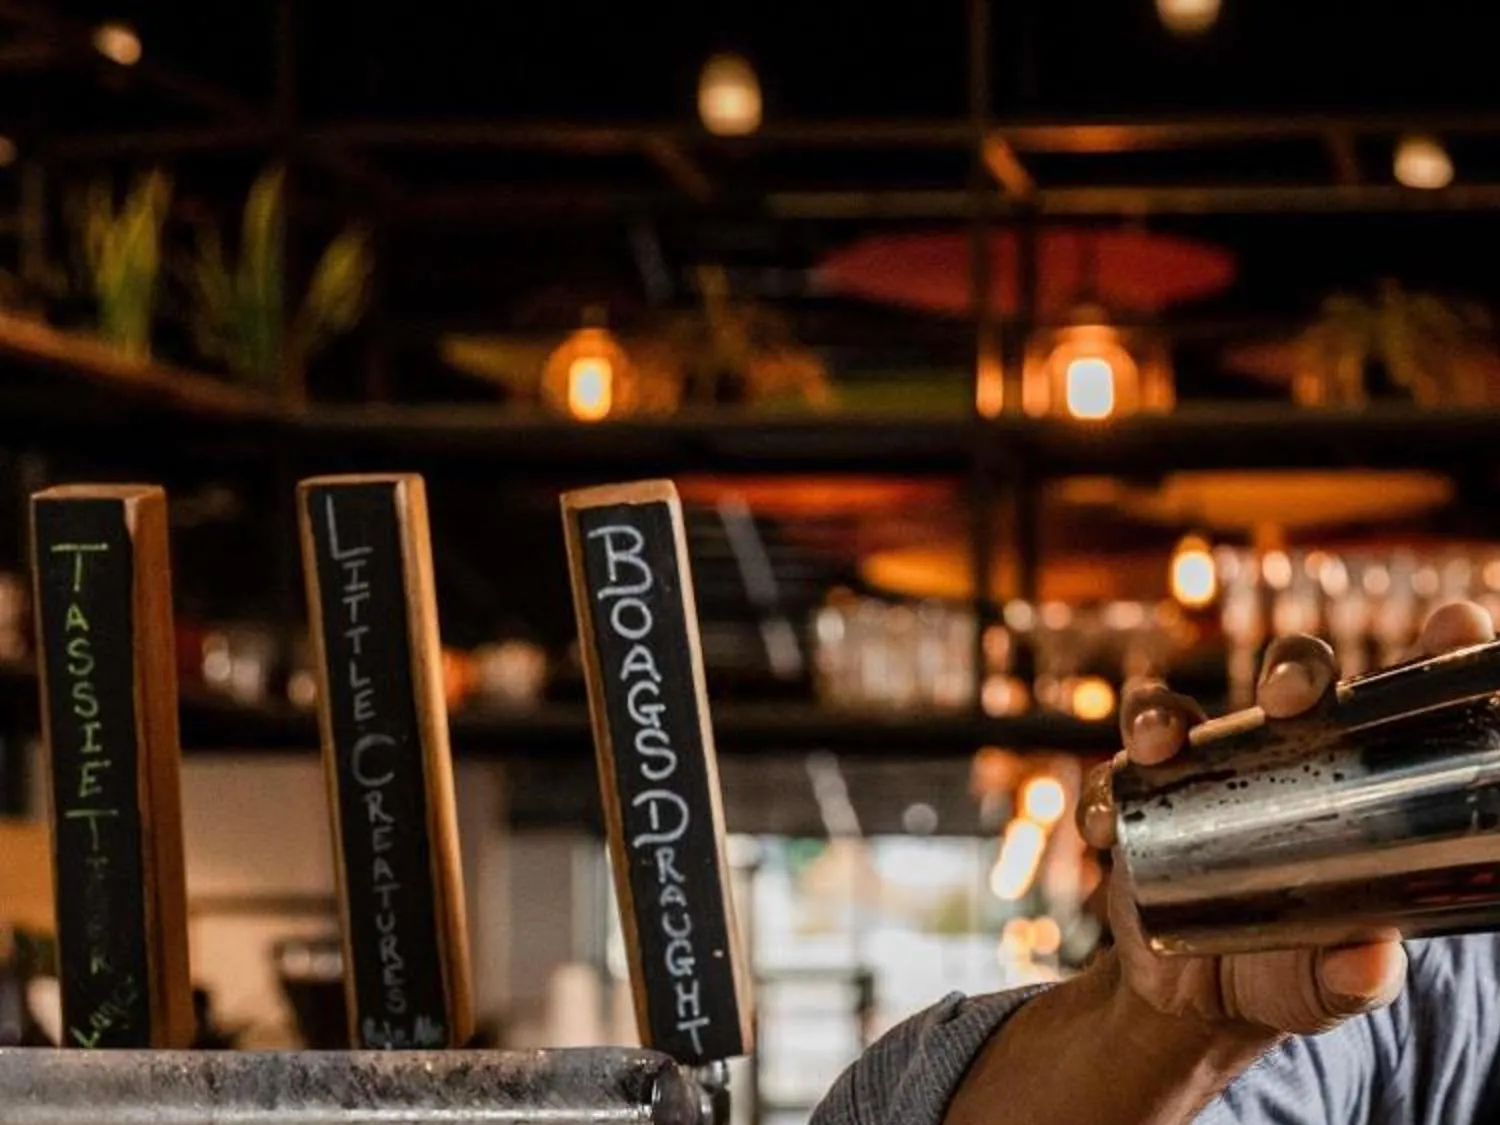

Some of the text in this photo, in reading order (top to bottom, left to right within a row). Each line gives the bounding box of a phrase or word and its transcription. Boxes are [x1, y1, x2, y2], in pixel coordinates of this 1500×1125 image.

[50, 543, 111, 798] TASSIE
[326, 494, 376, 722] LITTLE
[351, 733, 407, 1014] CREATURES
[587, 524, 710, 1055] BOAGS DRAUGHT
